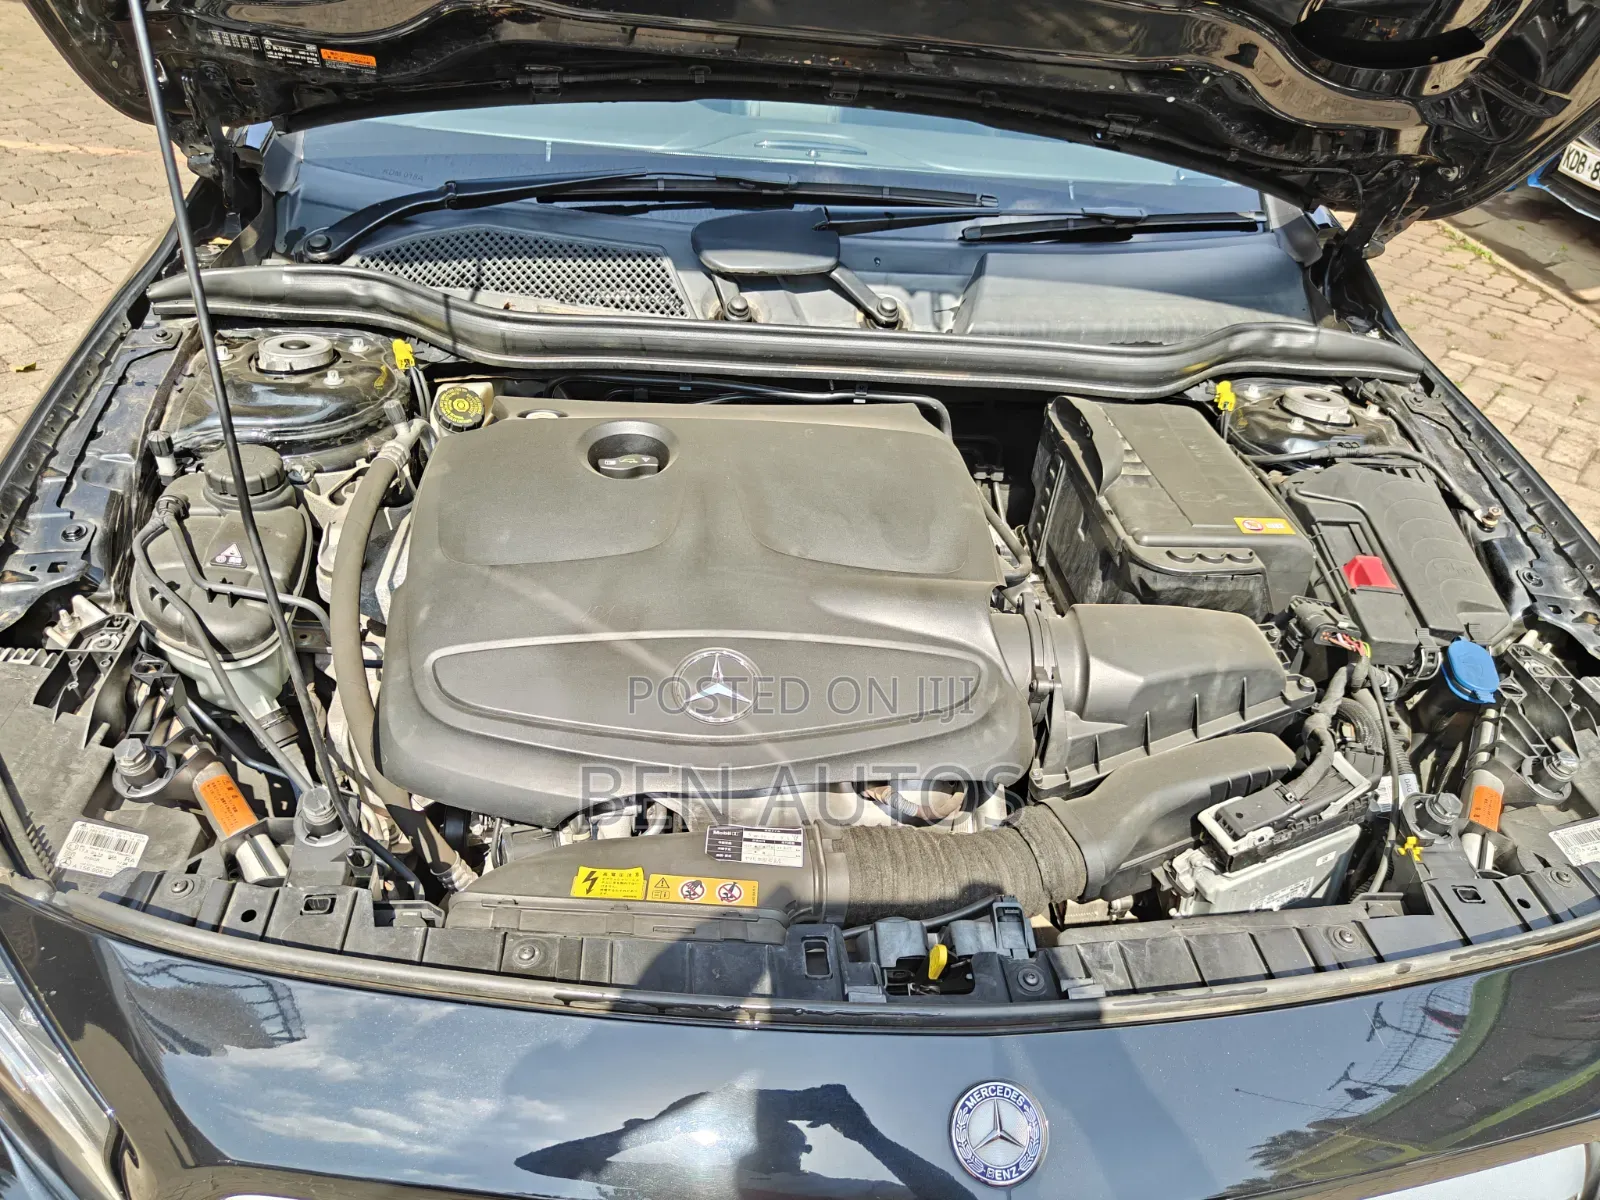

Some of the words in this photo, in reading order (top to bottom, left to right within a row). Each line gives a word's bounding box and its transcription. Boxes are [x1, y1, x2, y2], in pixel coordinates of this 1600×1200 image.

[1590, 161, 1600, 182] 8
[965, 1086, 1025, 1109] MERCEDES
[985, 1166, 1019, 1180] BENZ
